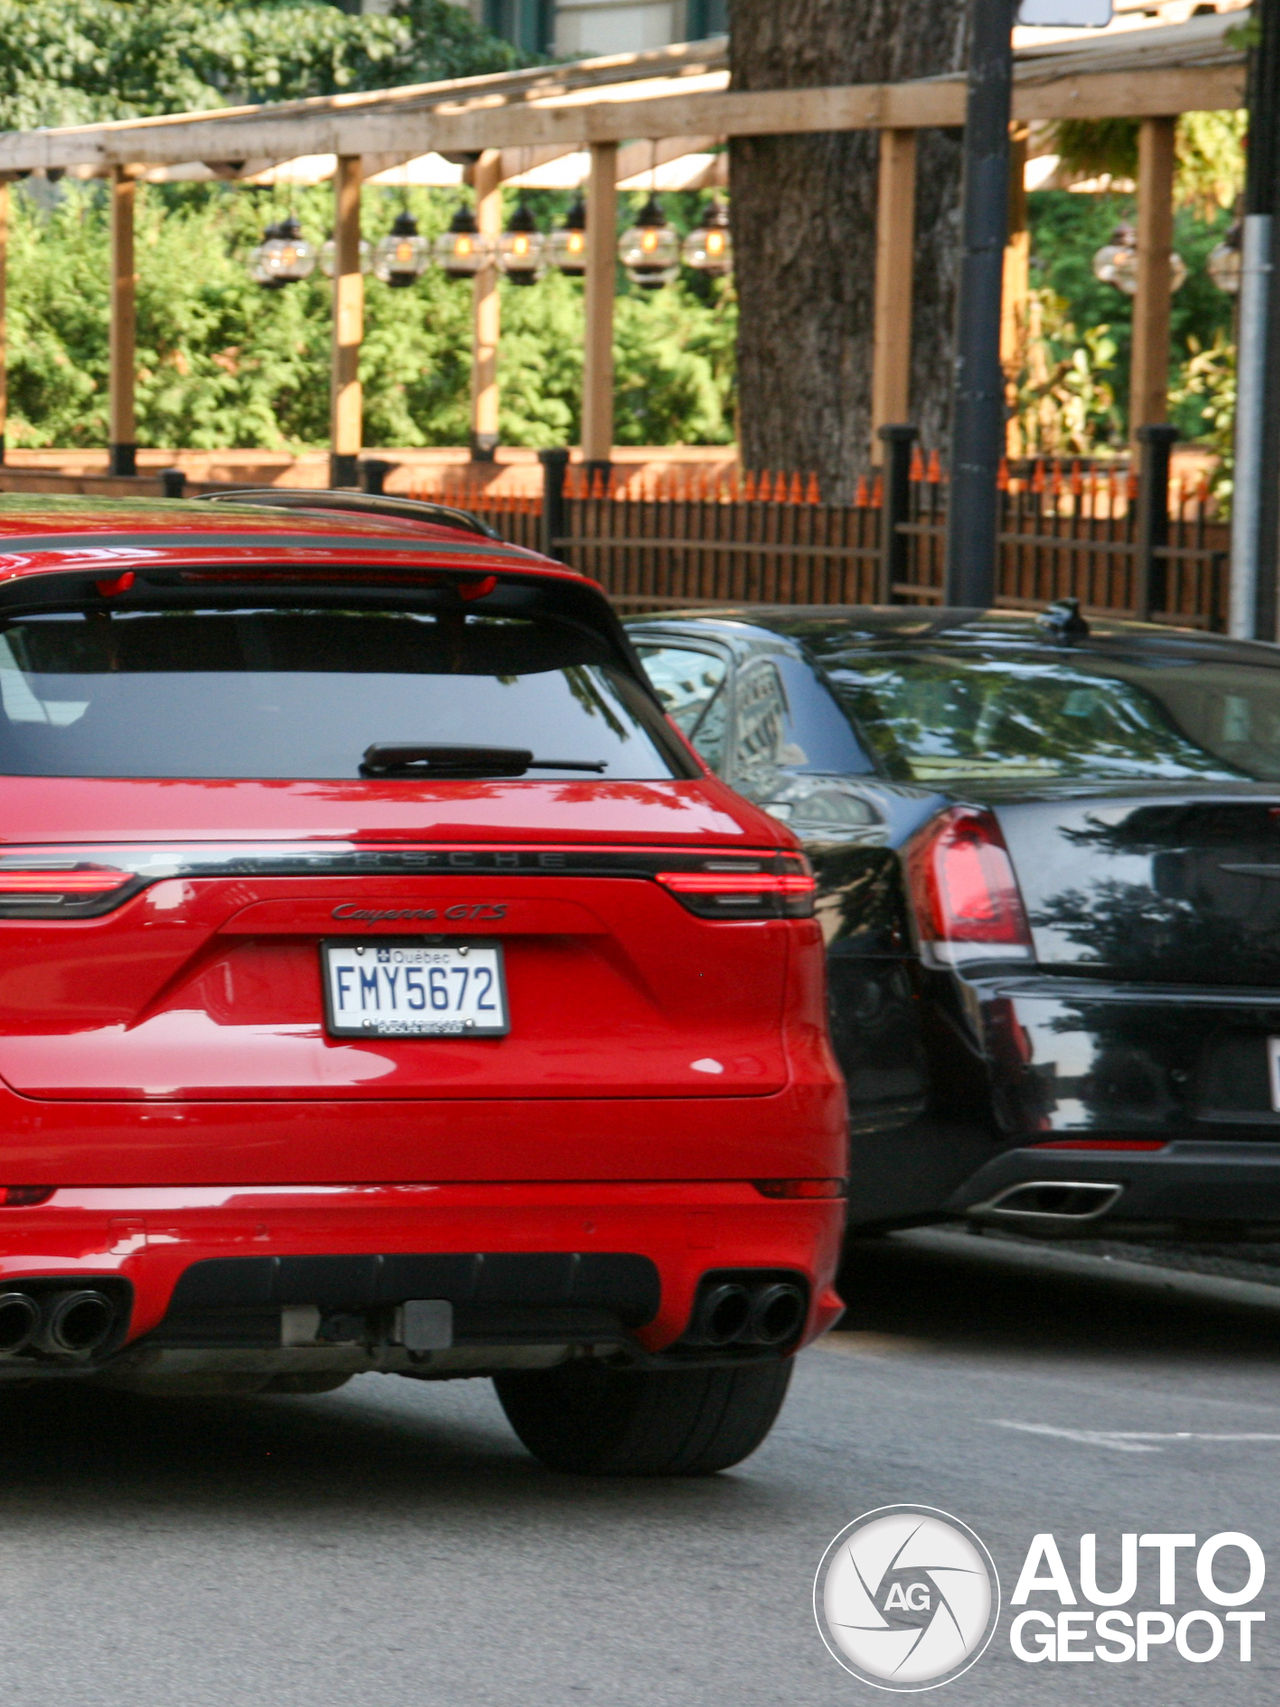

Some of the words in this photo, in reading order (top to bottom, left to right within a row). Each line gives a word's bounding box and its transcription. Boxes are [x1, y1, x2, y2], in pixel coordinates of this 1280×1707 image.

[331, 903, 438, 926] Cayenne
[444, 904, 510, 921] GTS
[392, 950, 451, 964] Québec
[336, 965, 497, 1012] FMY5672
